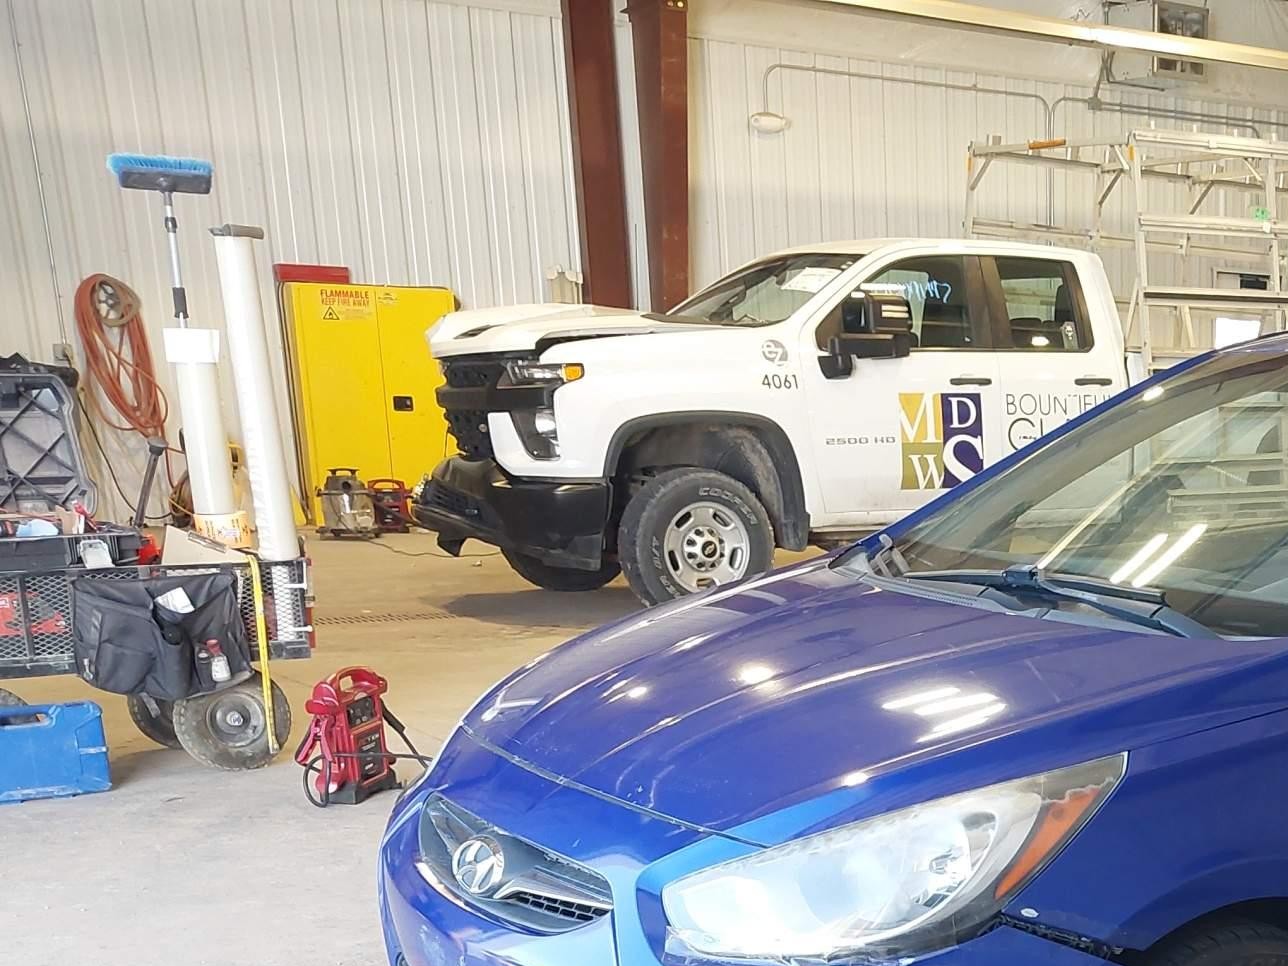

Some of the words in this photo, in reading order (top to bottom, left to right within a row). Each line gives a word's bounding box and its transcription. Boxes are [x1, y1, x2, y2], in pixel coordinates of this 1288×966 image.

[320, 289, 369, 299] FLAMMABLE
[761, 374, 798, 389] 4061
[948, 397, 977, 428] D
[825, 437, 869, 445] 2500
[874, 436, 896, 444] HD
[908, 454, 945, 490] W
